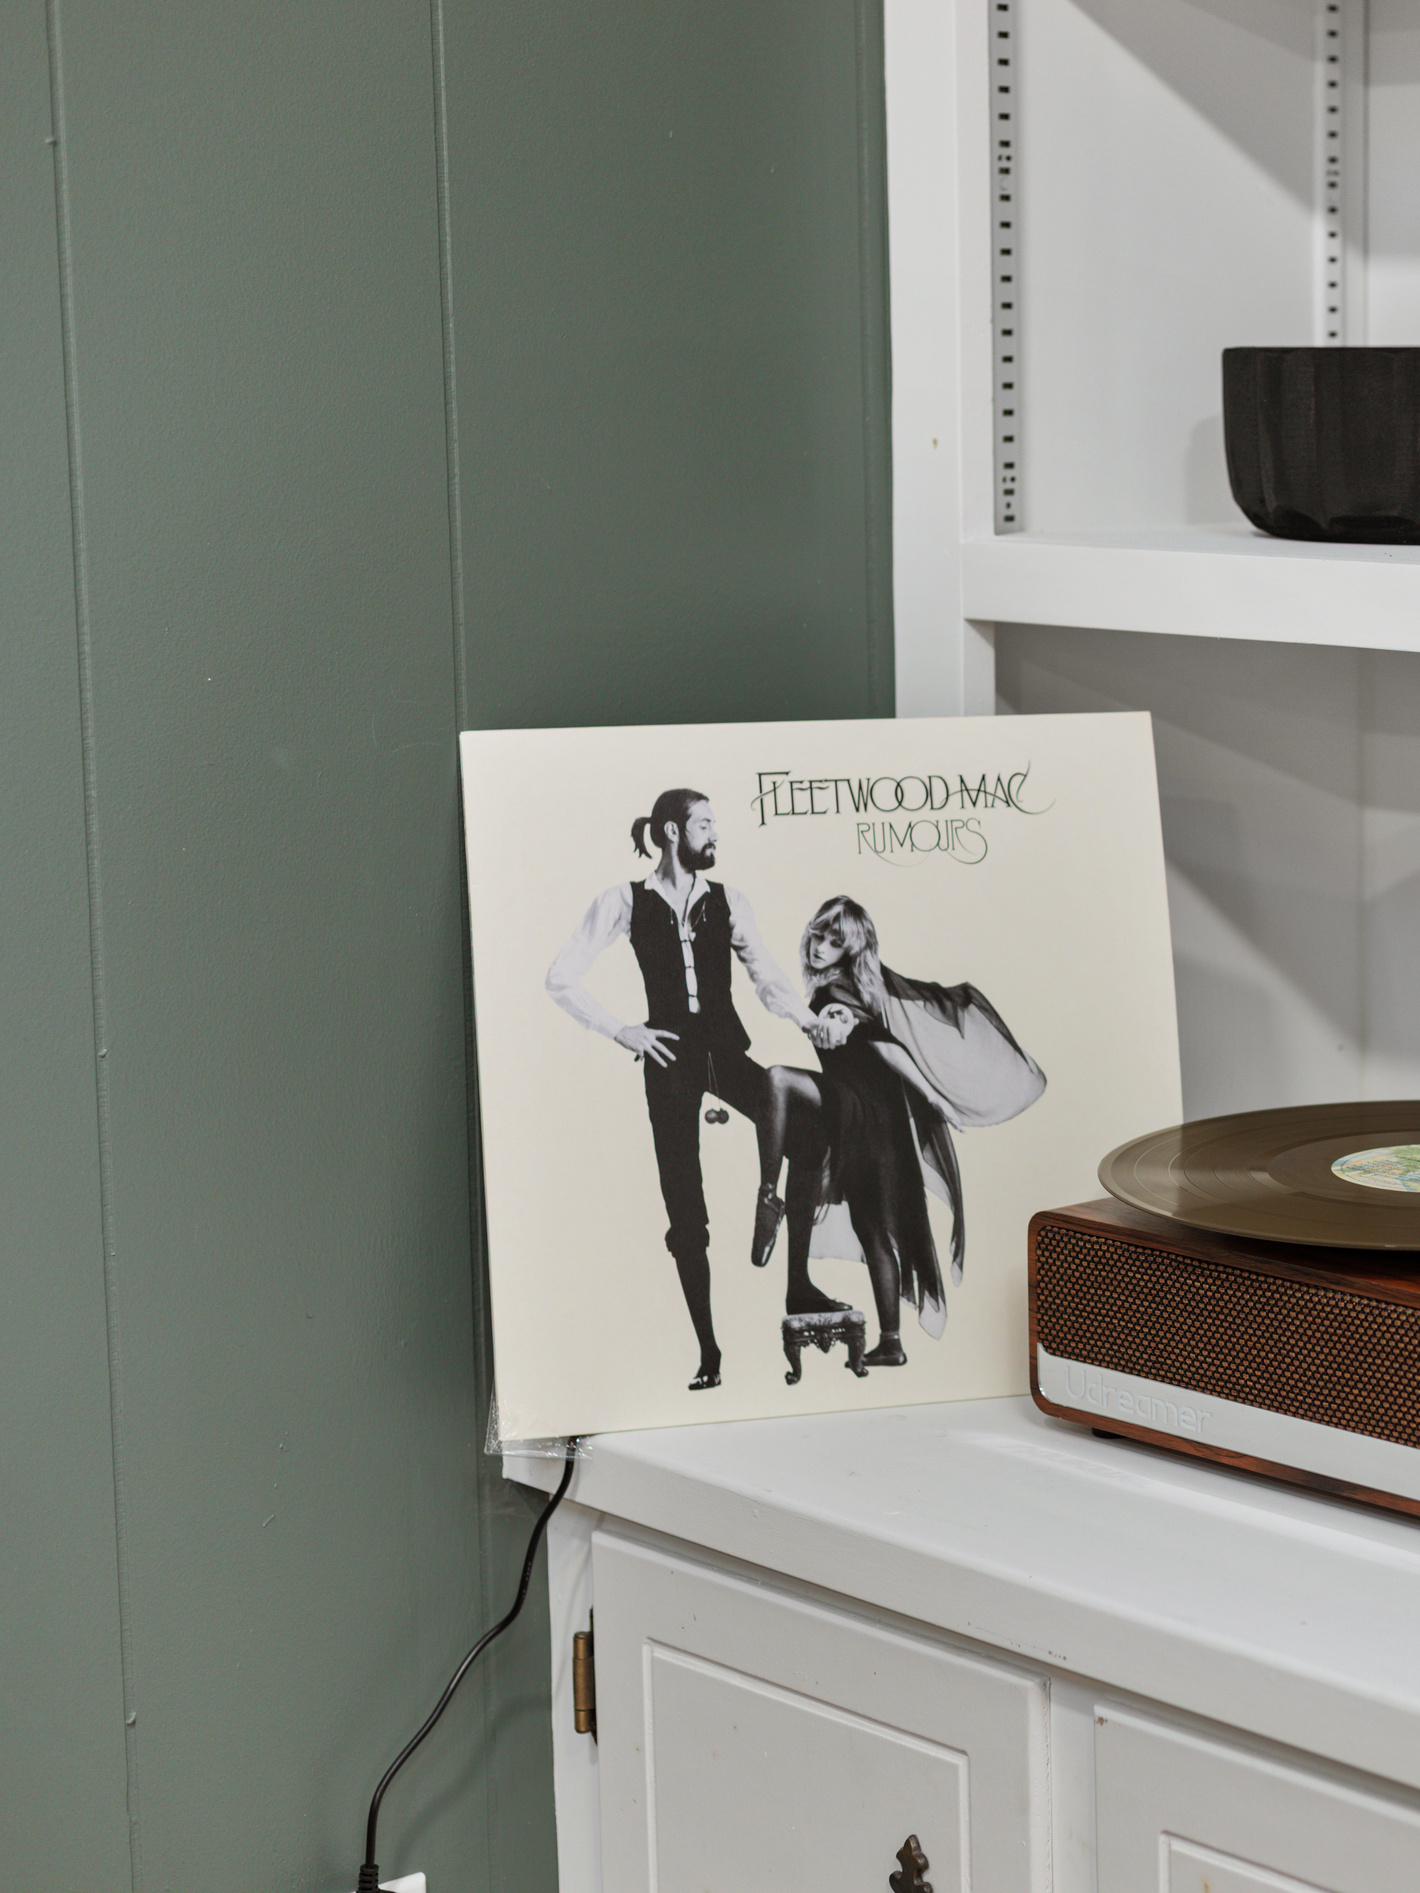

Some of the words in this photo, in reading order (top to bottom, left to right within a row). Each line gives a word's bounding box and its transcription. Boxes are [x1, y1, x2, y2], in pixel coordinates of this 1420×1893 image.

[750, 770, 950, 828] FLEETWOOD
[956, 759, 1056, 815] MAC
[856, 817, 988, 867] RUMOURS
